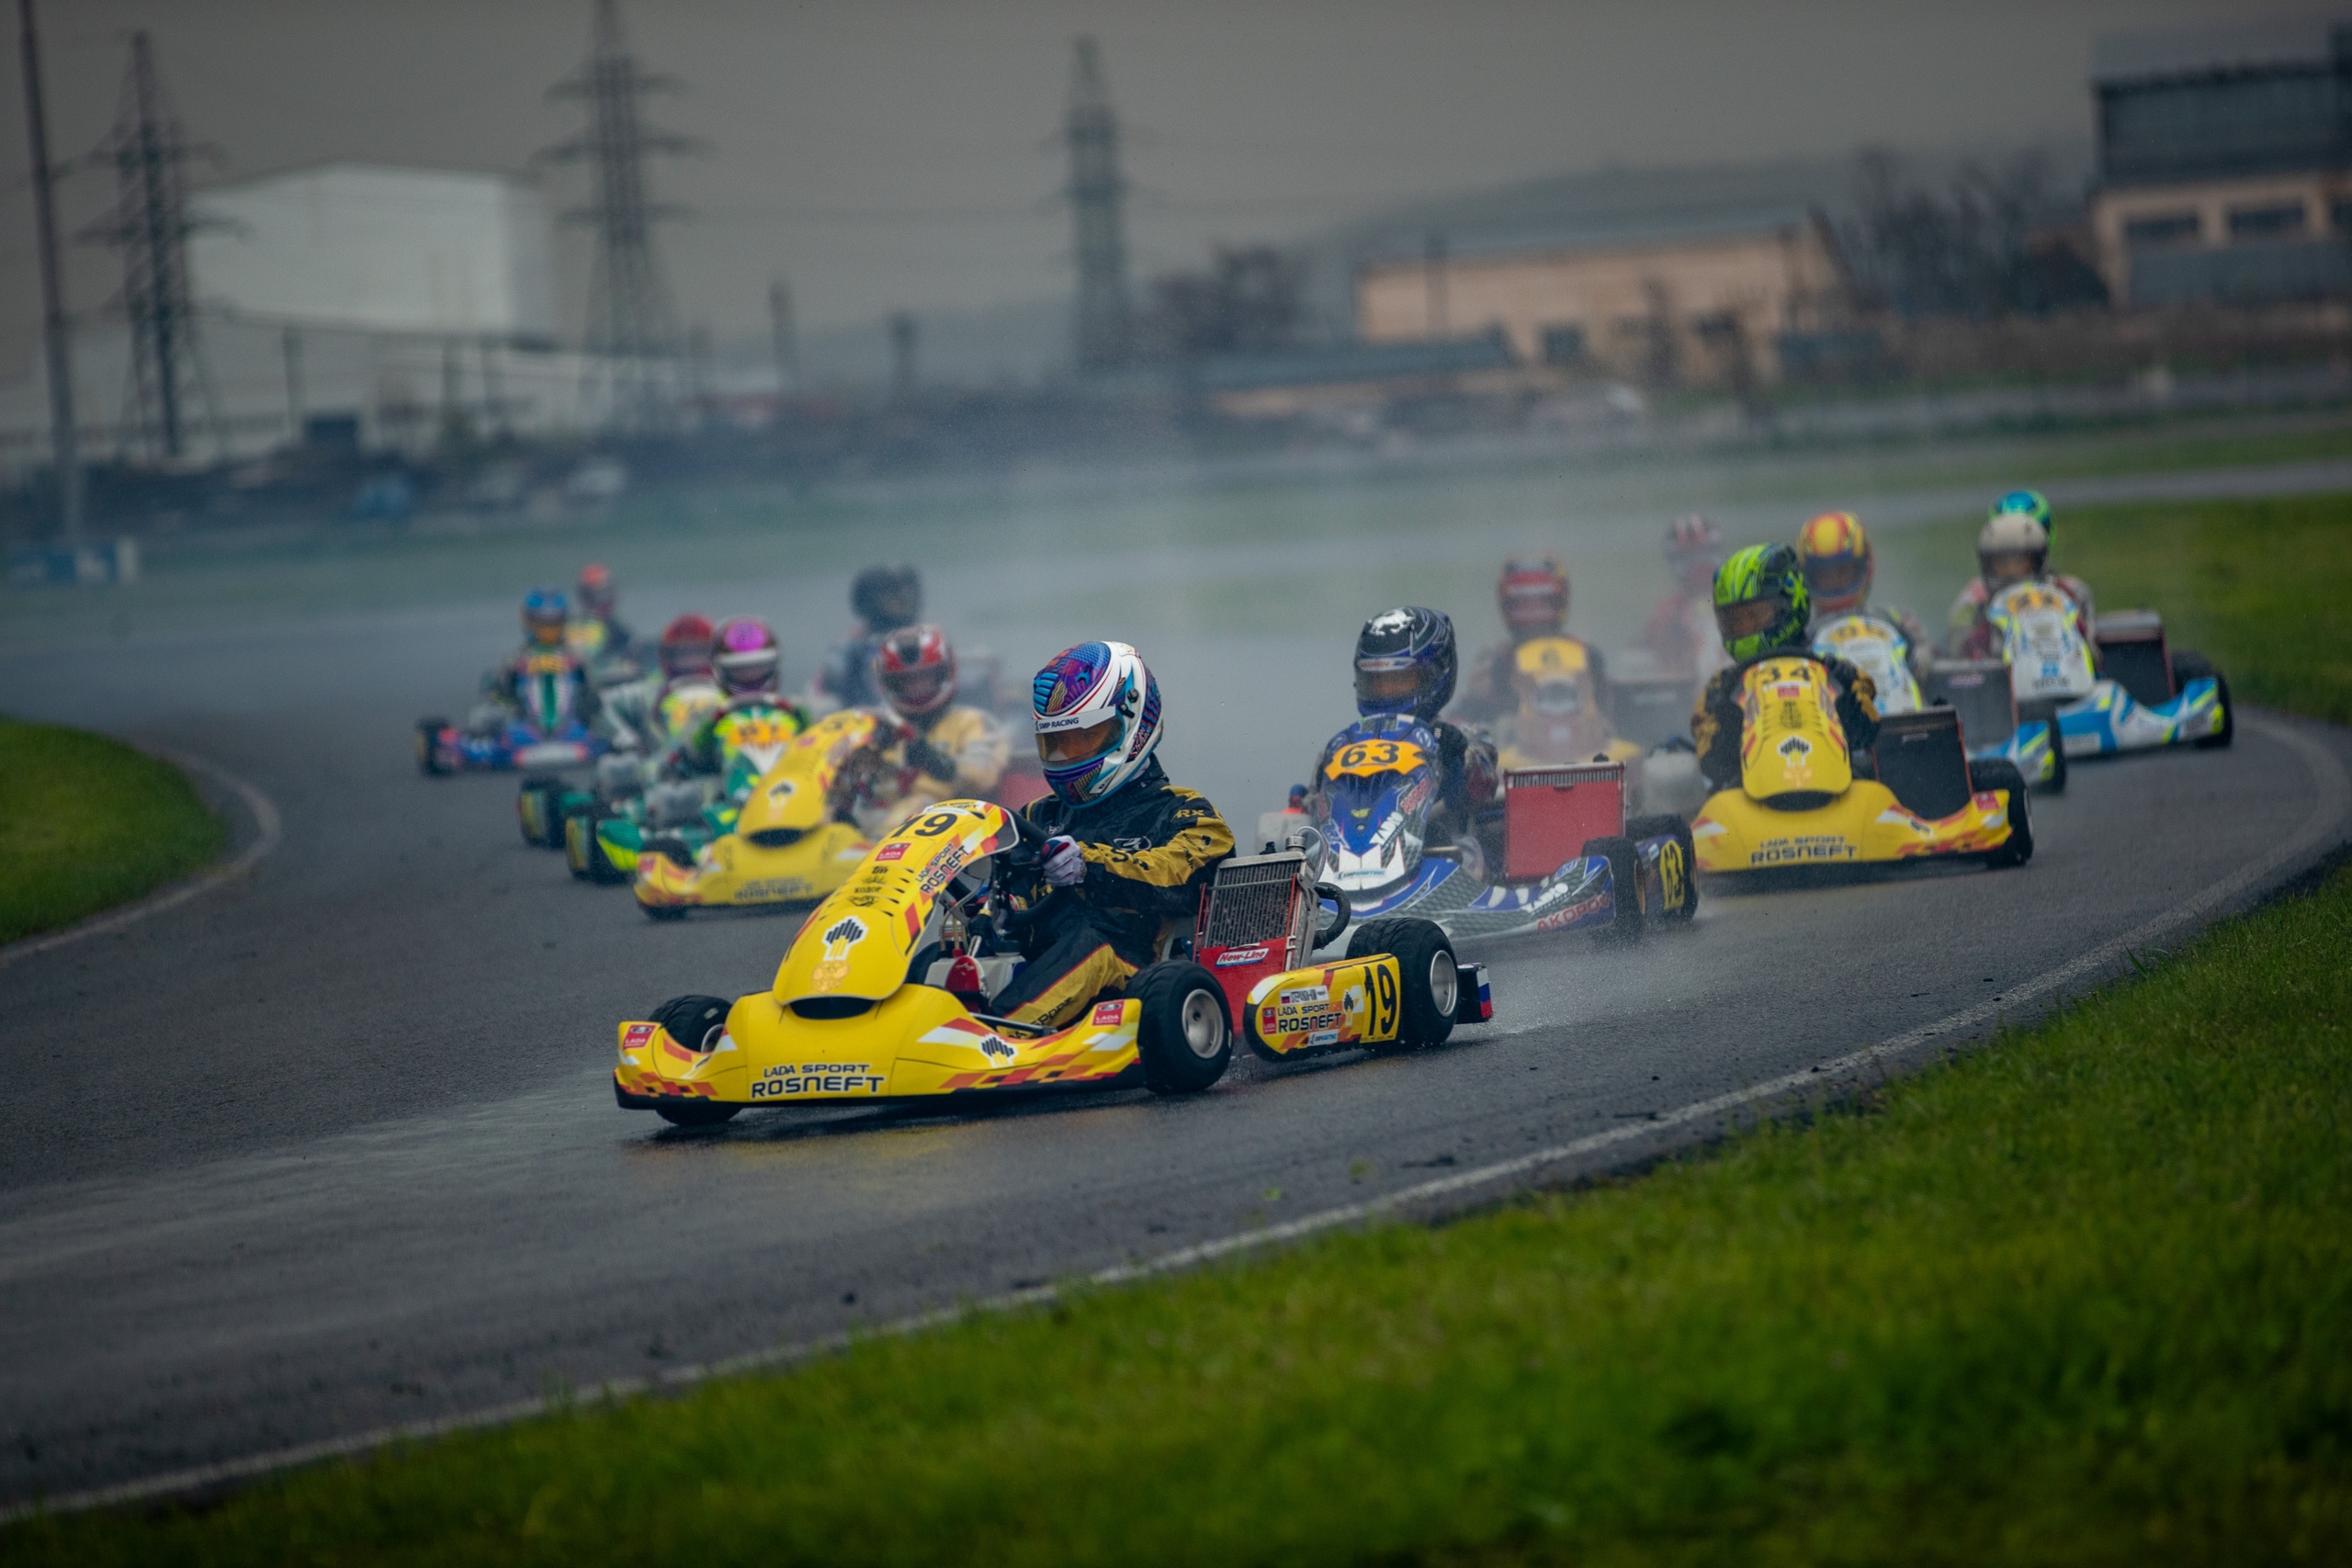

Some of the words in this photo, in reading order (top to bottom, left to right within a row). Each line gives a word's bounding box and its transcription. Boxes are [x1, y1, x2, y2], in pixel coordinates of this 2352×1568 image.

[1039, 722, 1051, 730] SMP
[1051, 717, 1080, 728] RACING
[1340, 743, 1400, 768] 63
[889, 813, 958, 839] 19
[931, 842, 955, 867] SPORT
[920, 845, 970, 894] ROSNEFT
[1278, 1006, 1298, 1017] LADA
[1301, 1003, 1330, 1014] SPORT
[1363, 964, 1397, 1036] 19
[1278, 1012, 1342, 1033] ROSNEFT
[763, 1065, 796, 1078] LADA
[801, 1064, 870, 1074] SPORT
[751, 1077, 885, 1100] ROSNEFT
